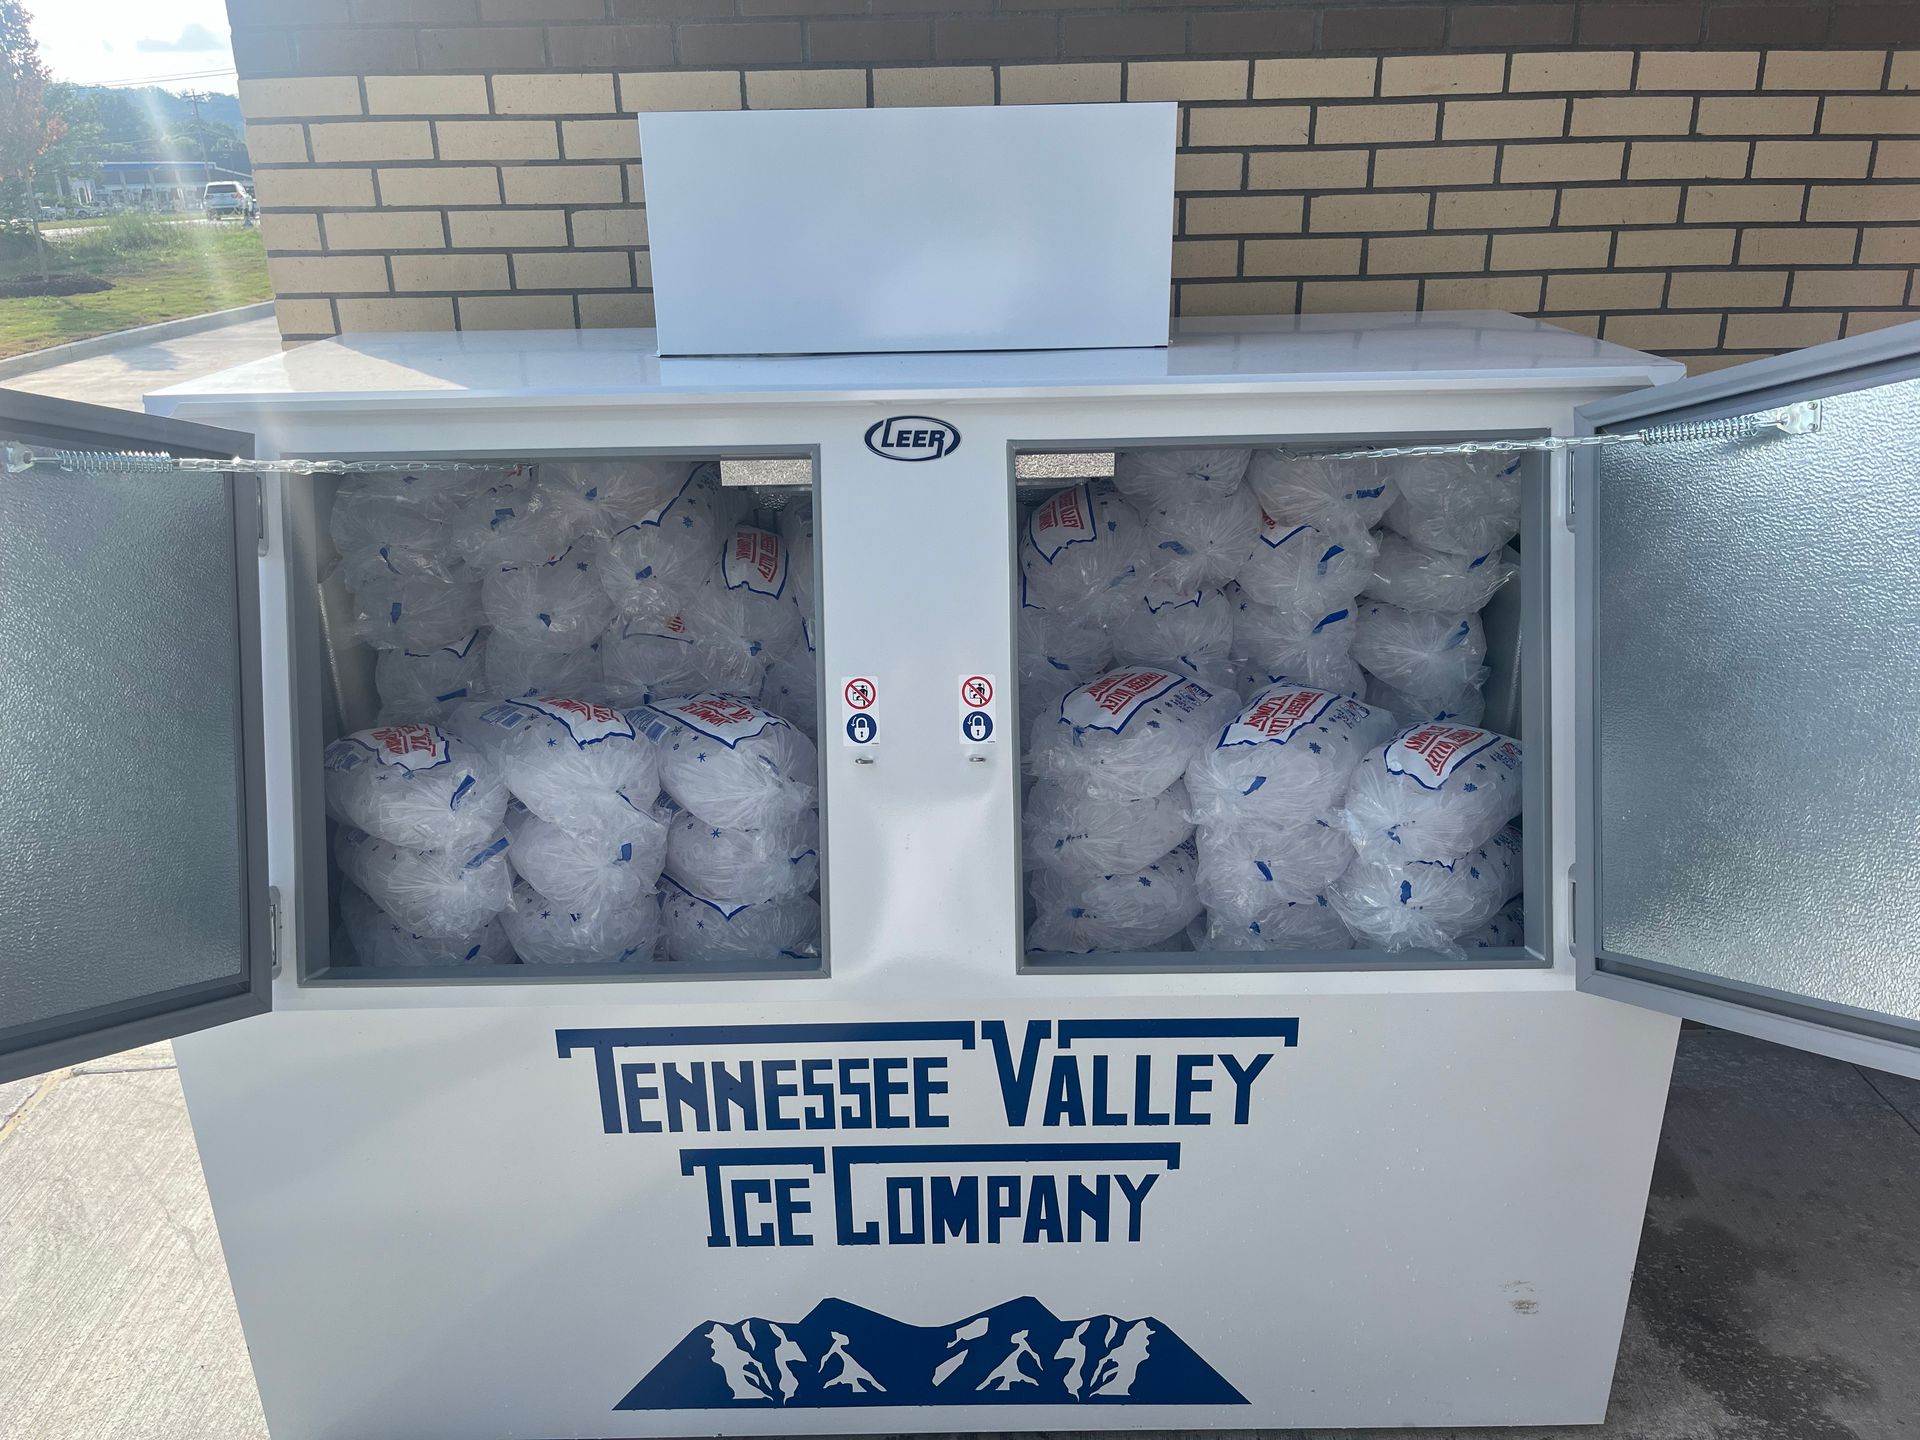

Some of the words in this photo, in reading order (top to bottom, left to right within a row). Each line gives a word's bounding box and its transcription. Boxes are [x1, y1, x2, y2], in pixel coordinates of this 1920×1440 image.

[881, 419, 946, 458] LEER
[555, 1021, 975, 1134] TENNESSEE
[981, 1017, 1299, 1127] VALLEY
[679, 1146, 826, 1248] ICE
[832, 1142, 1181, 1246] COMPANY
